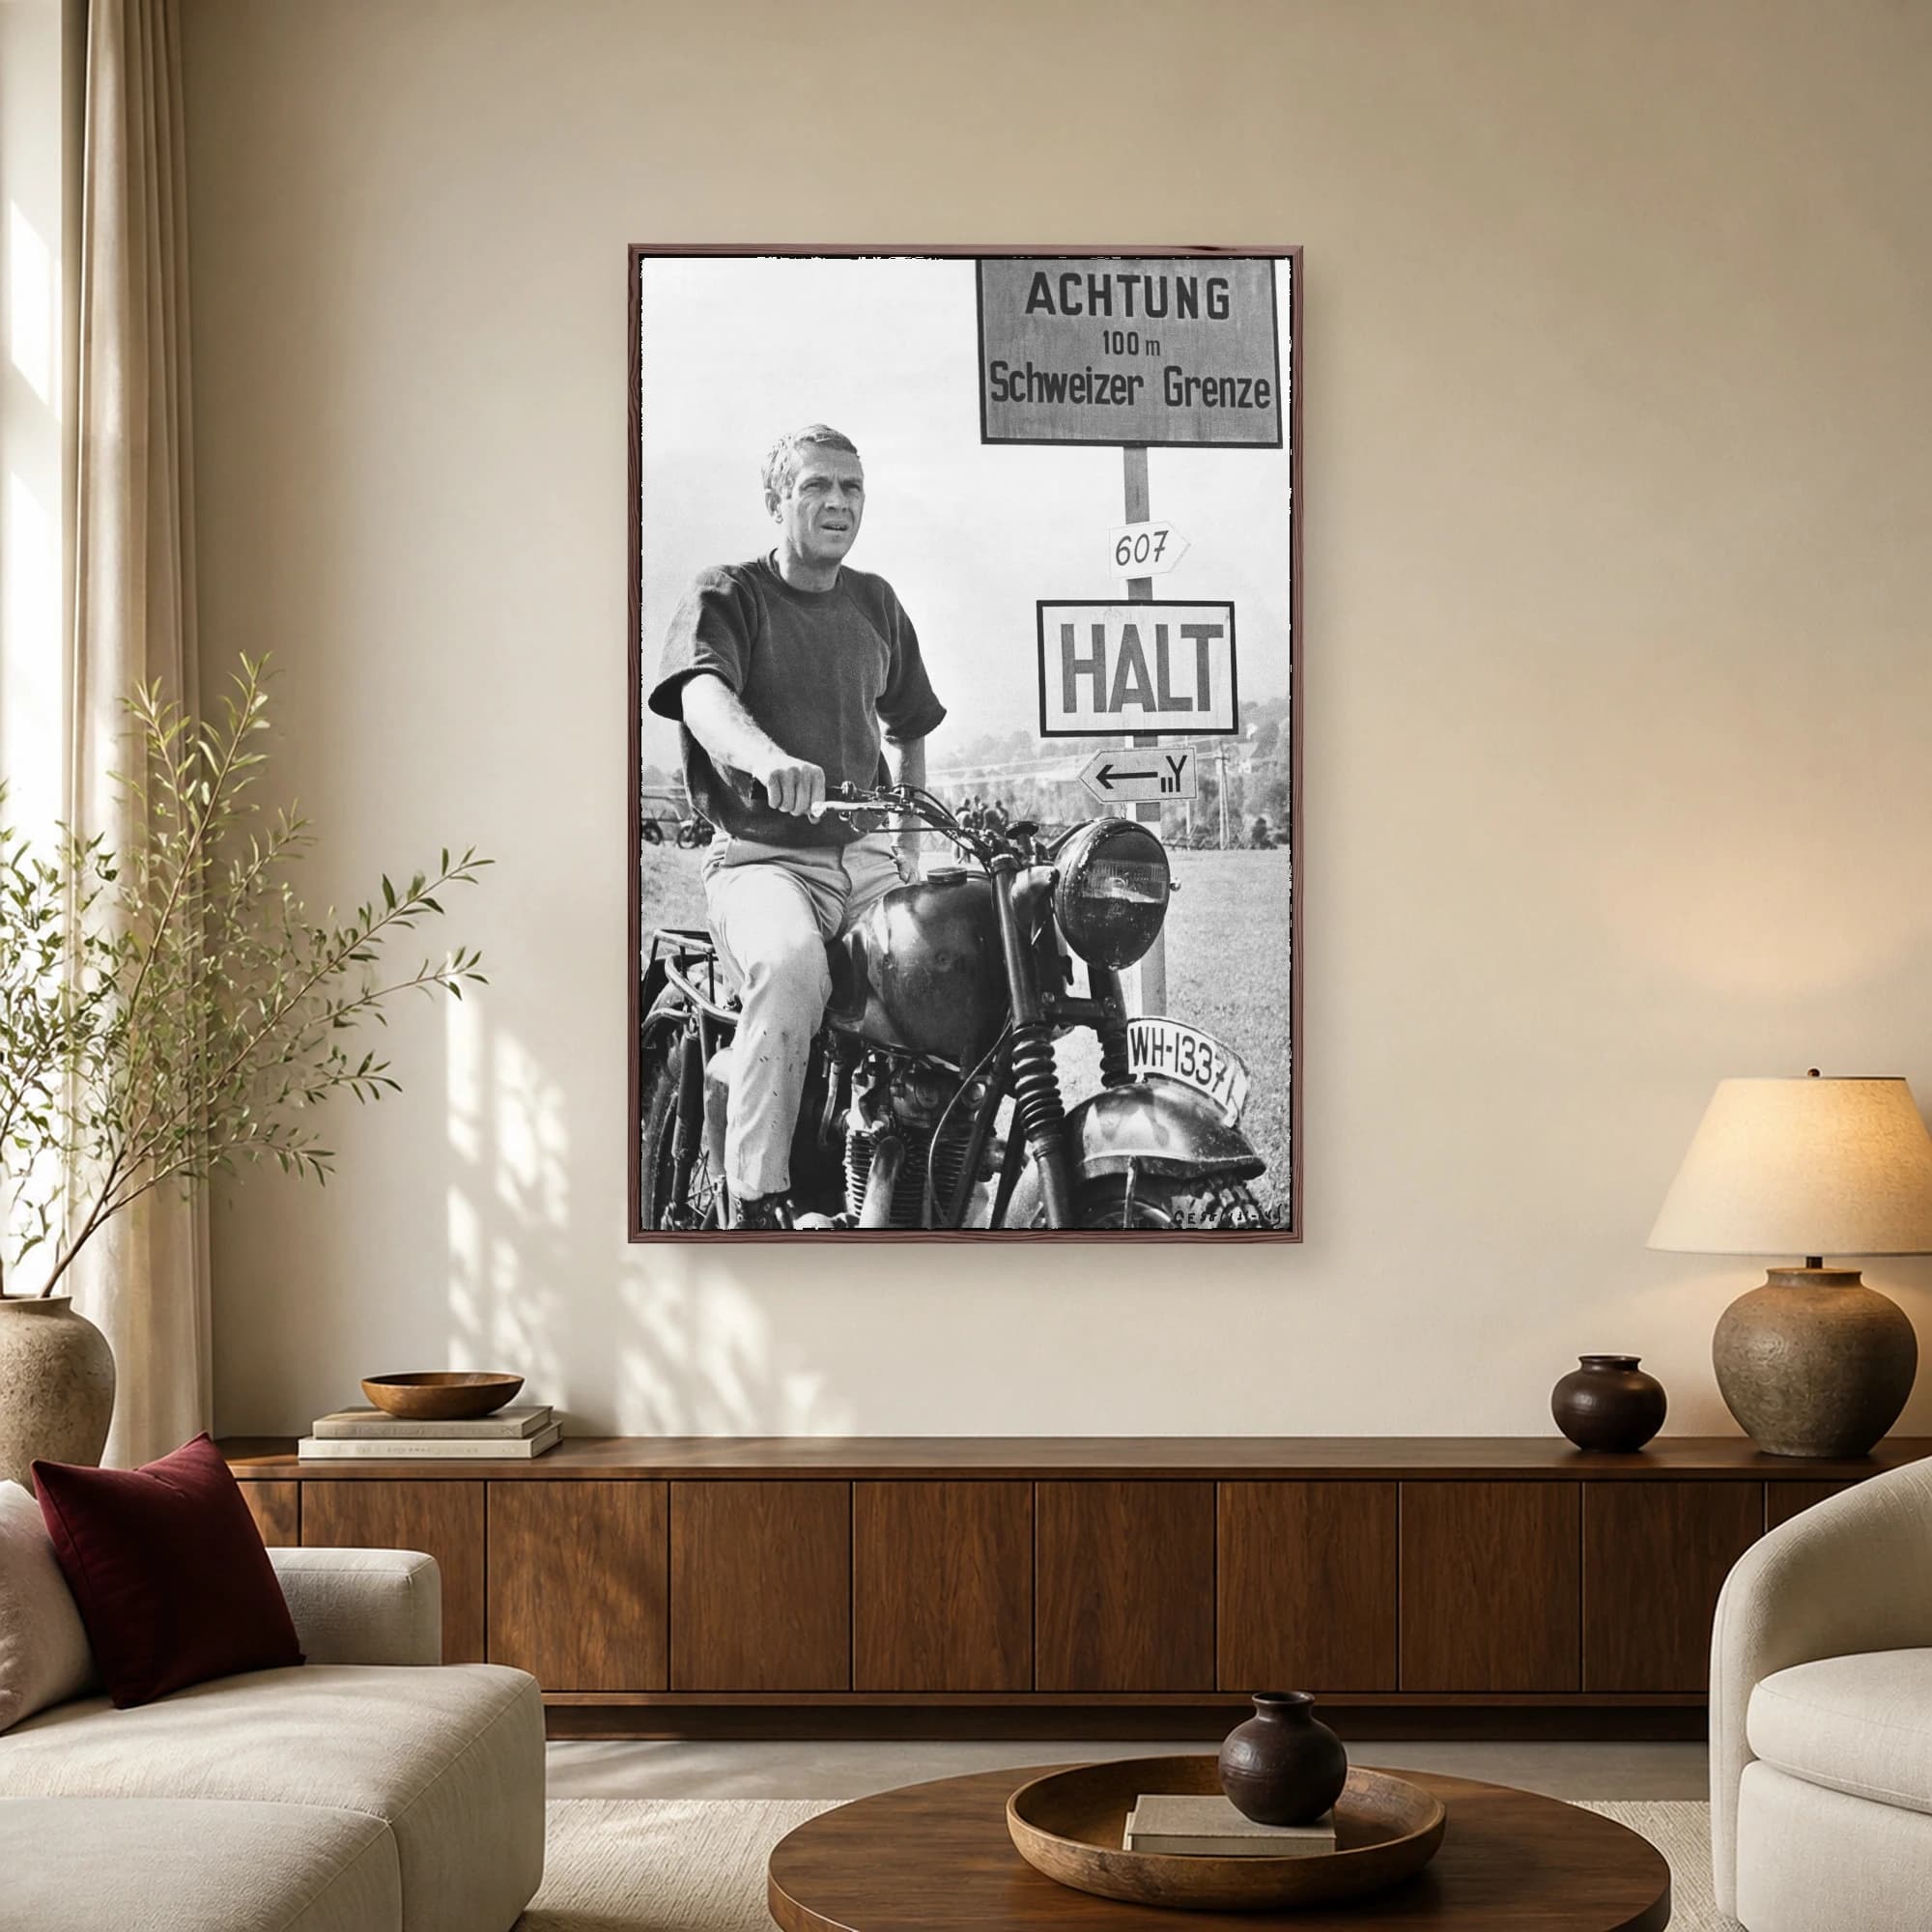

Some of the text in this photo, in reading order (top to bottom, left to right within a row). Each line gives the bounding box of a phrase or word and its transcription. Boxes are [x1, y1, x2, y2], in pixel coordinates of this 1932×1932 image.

[1025, 271, 1230, 320] ACHTUNG
[1103, 330, 1161, 356] 100 m
[990, 360, 1271, 409] Schweizer Grenze
[1115, 530, 1170, 566] 607
[1061, 623, 1224, 714] HALT
